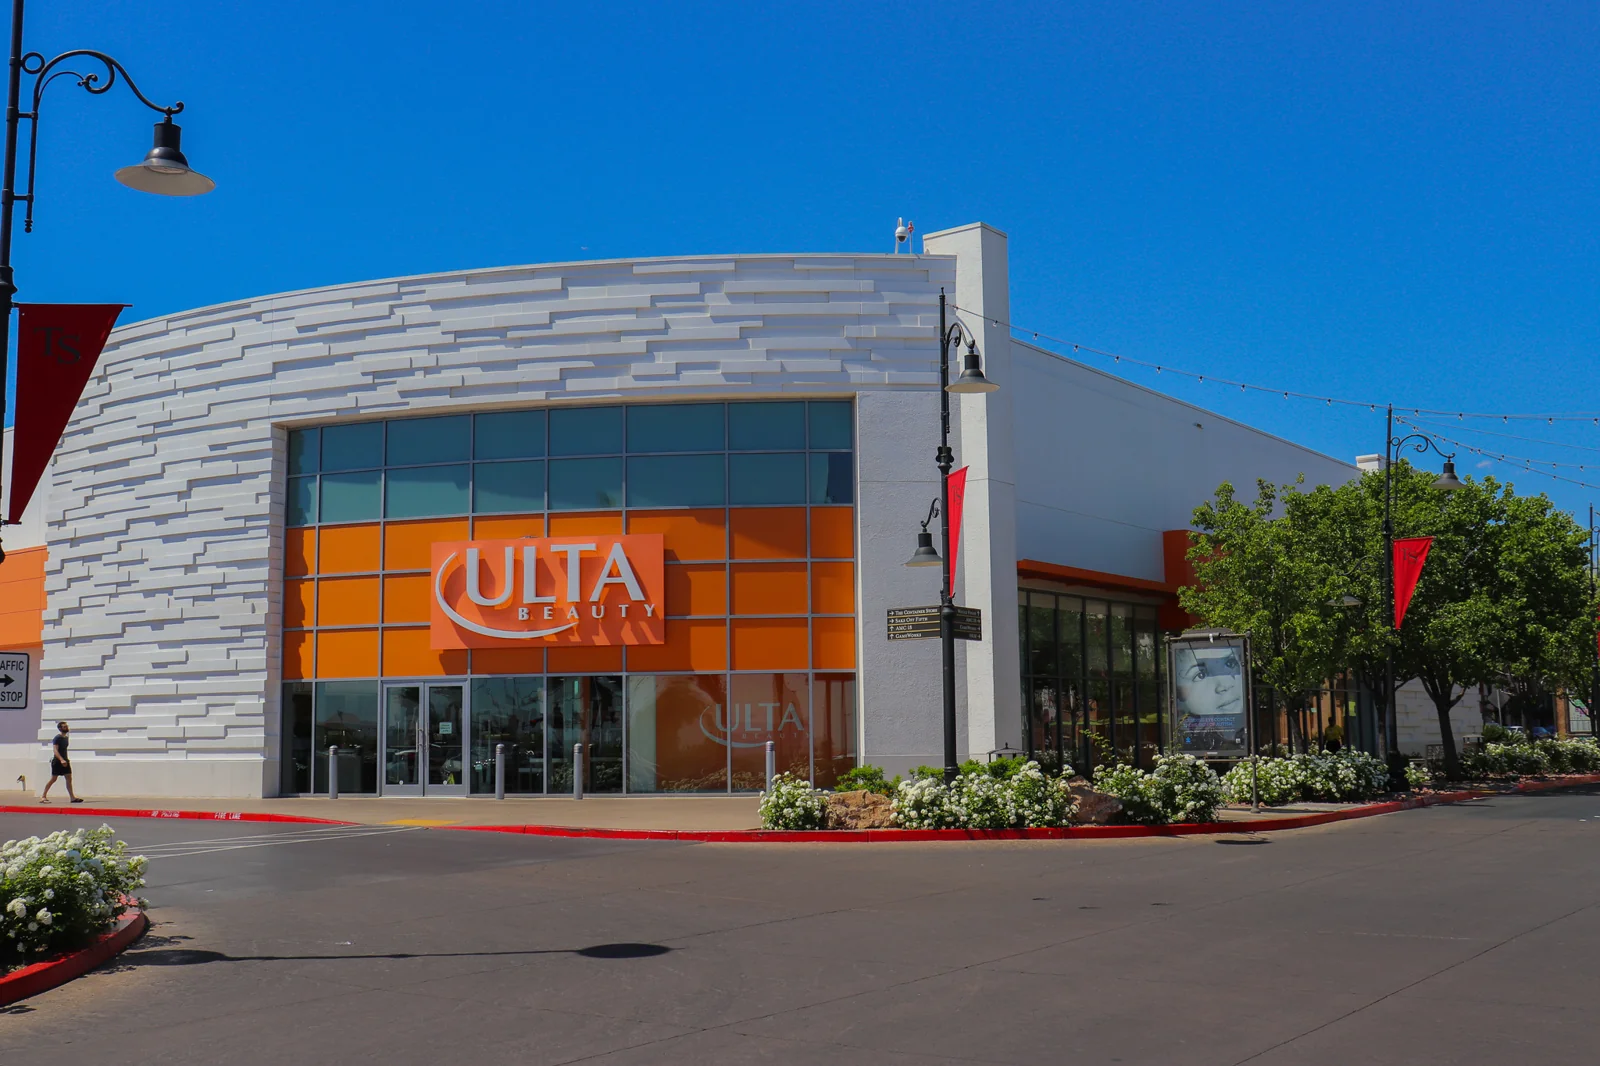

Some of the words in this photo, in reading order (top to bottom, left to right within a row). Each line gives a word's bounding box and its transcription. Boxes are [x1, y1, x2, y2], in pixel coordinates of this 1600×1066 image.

[466, 543, 646, 606] ULTA
[518, 604, 656, 621] BEAUTY
[0, 691, 23, 702] STOP
[715, 702, 804, 732] ULTA
